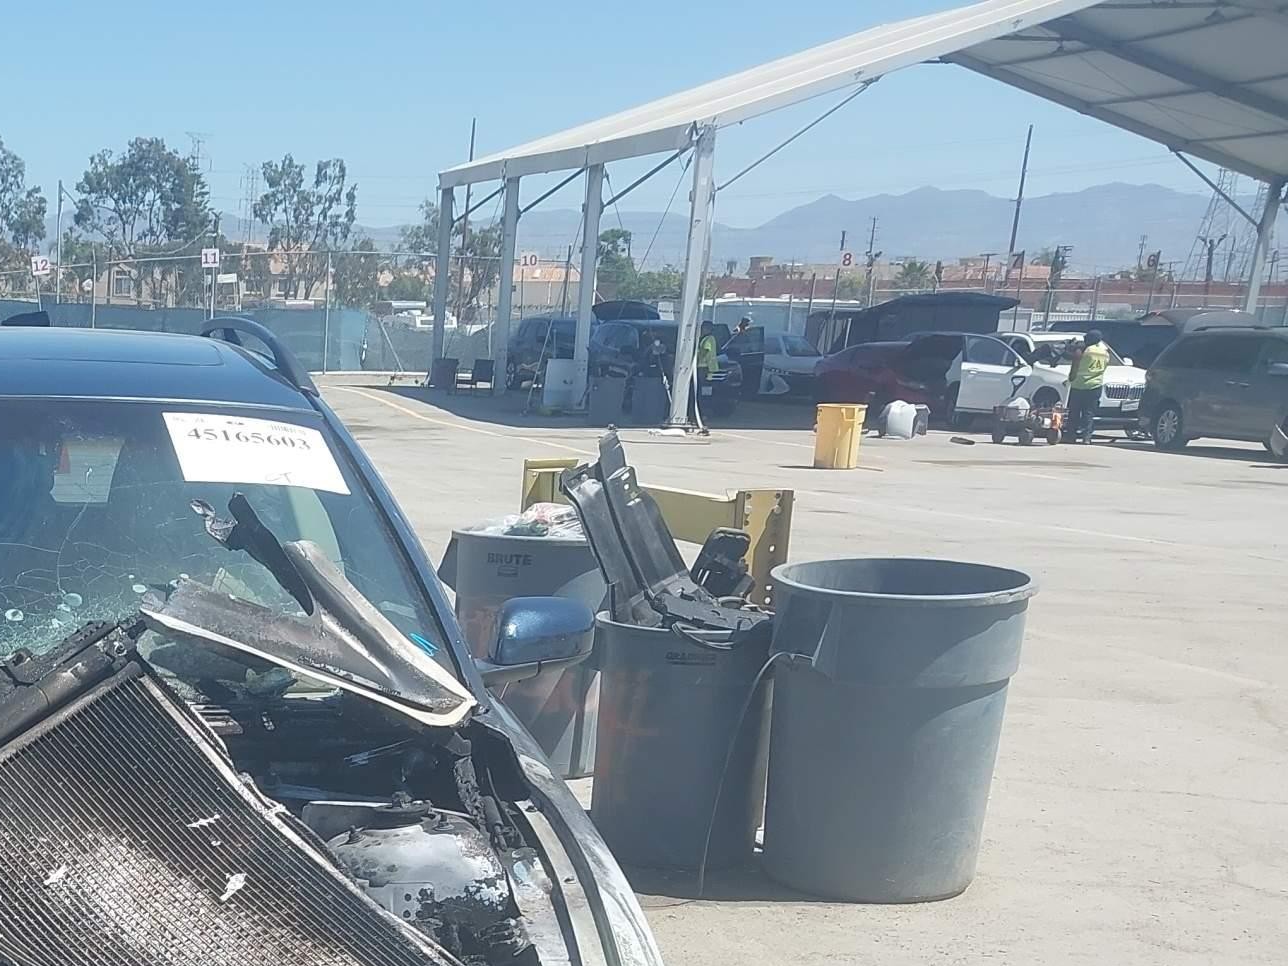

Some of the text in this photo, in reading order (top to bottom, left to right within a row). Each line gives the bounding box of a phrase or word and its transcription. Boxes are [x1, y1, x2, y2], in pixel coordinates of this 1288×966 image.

[203, 252, 217, 264] 11
[522, 255, 537, 266] 10
[842, 252, 852, 266] 8
[33, 259, 48, 271] 12
[187, 426, 312, 450] 45165603
[487, 552, 534, 566] BRUTE
